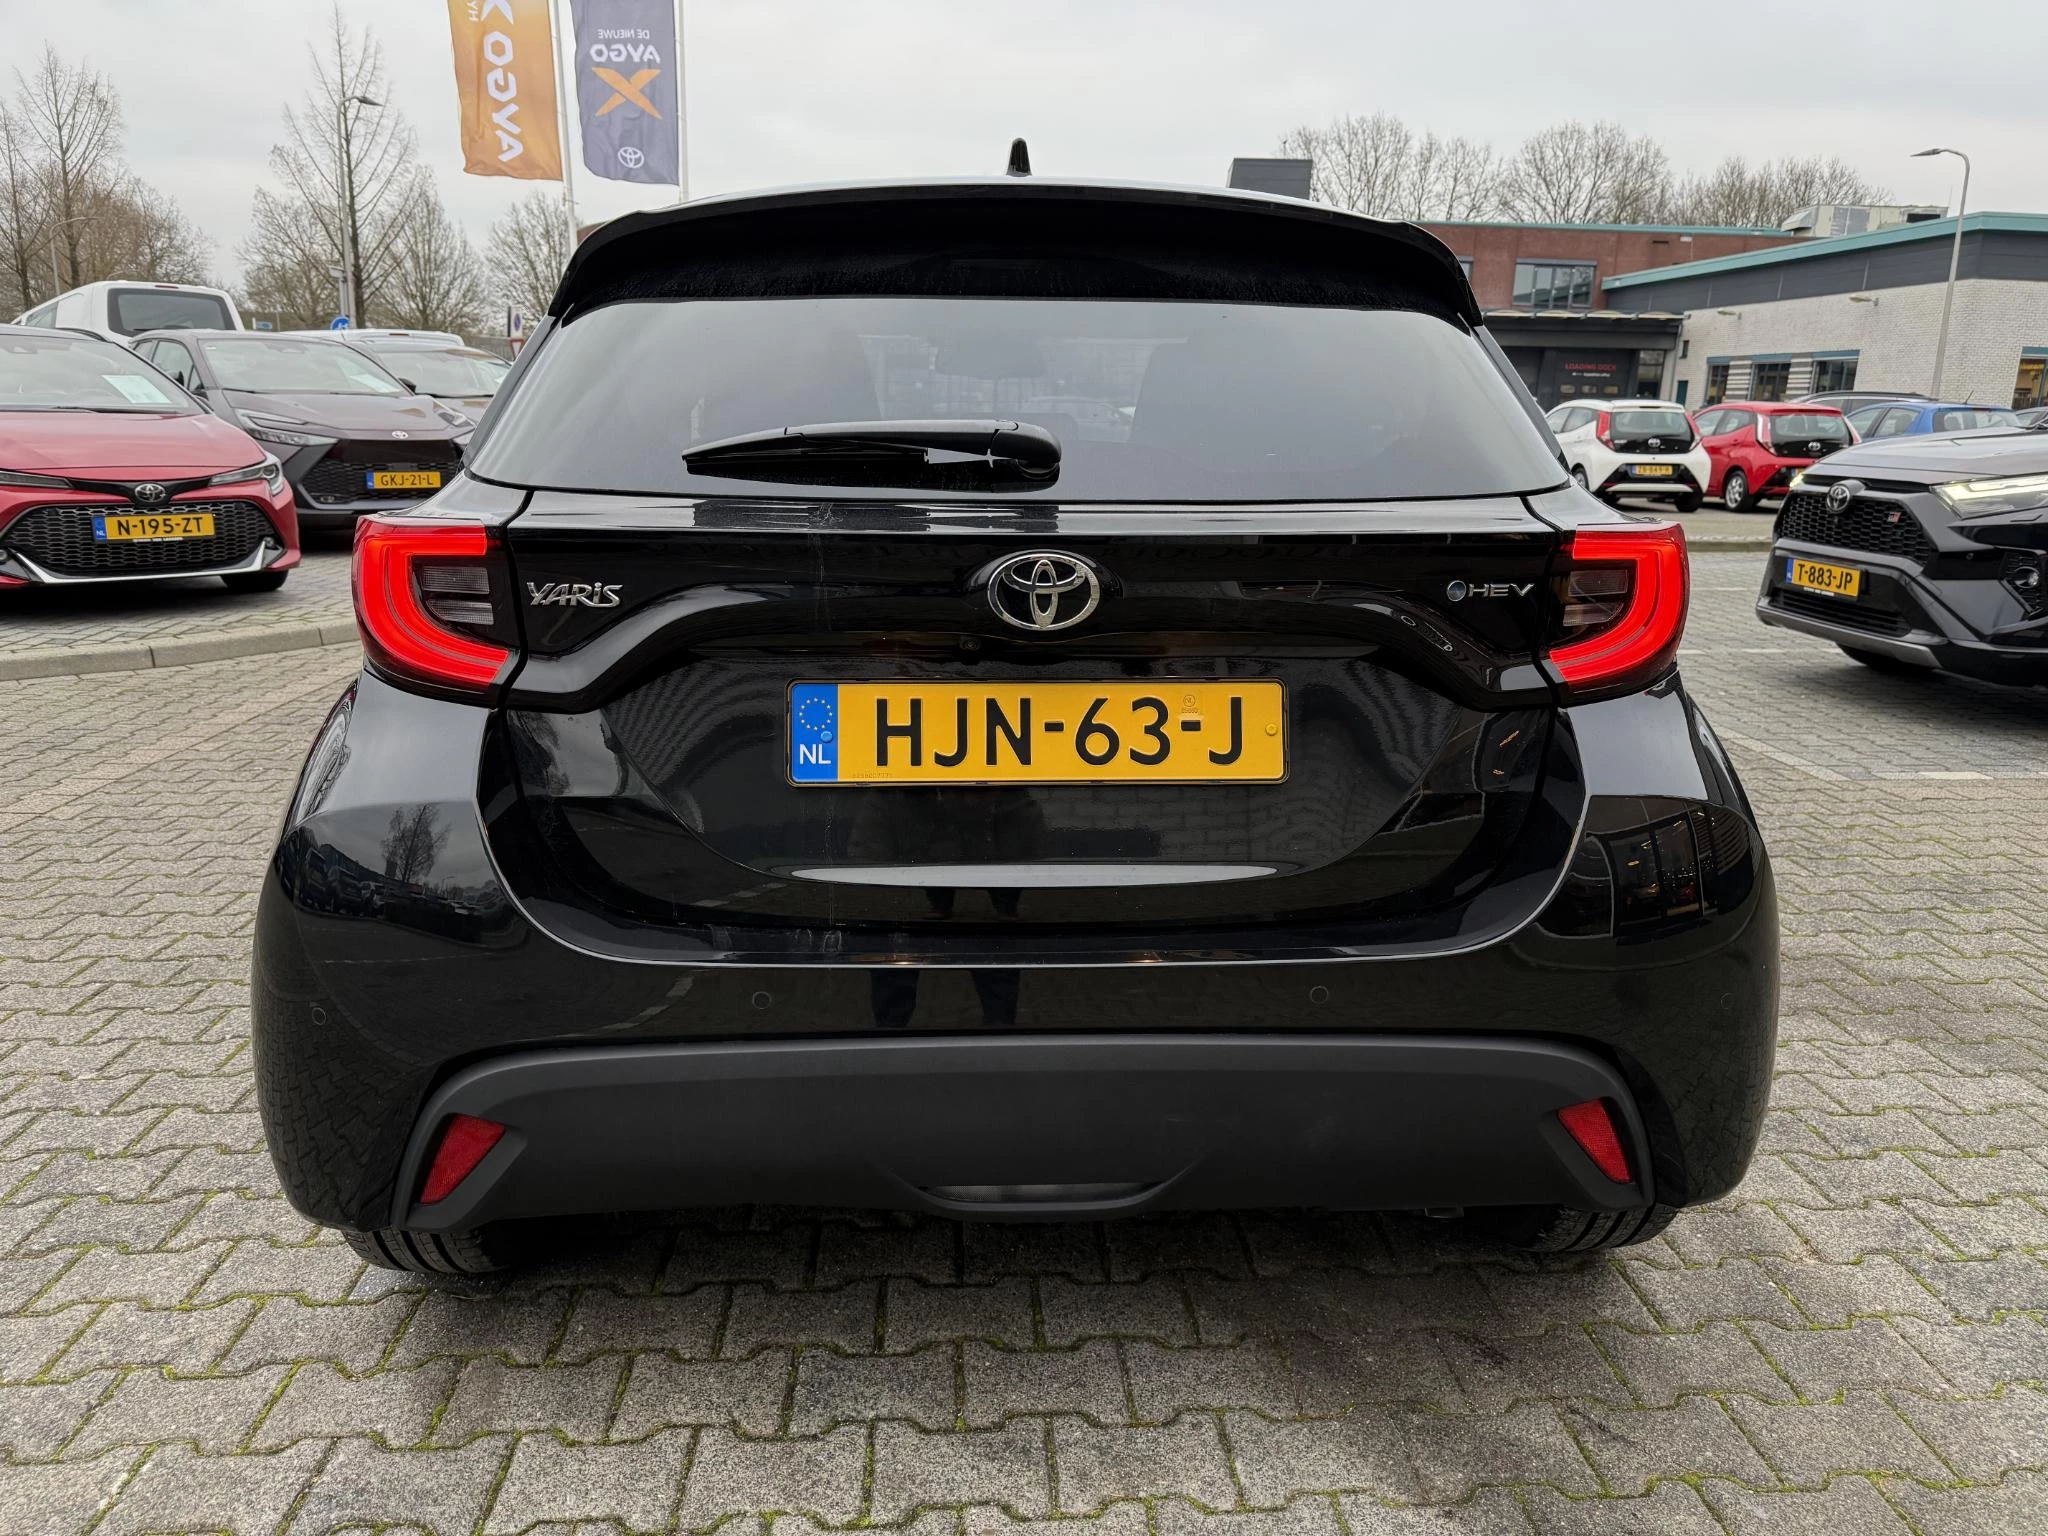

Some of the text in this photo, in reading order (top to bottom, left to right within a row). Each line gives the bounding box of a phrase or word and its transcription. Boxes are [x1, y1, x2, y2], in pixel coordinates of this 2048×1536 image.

[380, 474, 434, 486] GKJ-21-L
[116, 517, 203, 536] N-195-ZT
[1798, 563, 1853, 591] T-883-JP
[1468, 583, 1535, 597] HEV
[876, 696, 1243, 767] HJN-63-J
[800, 744, 832, 765] NL
